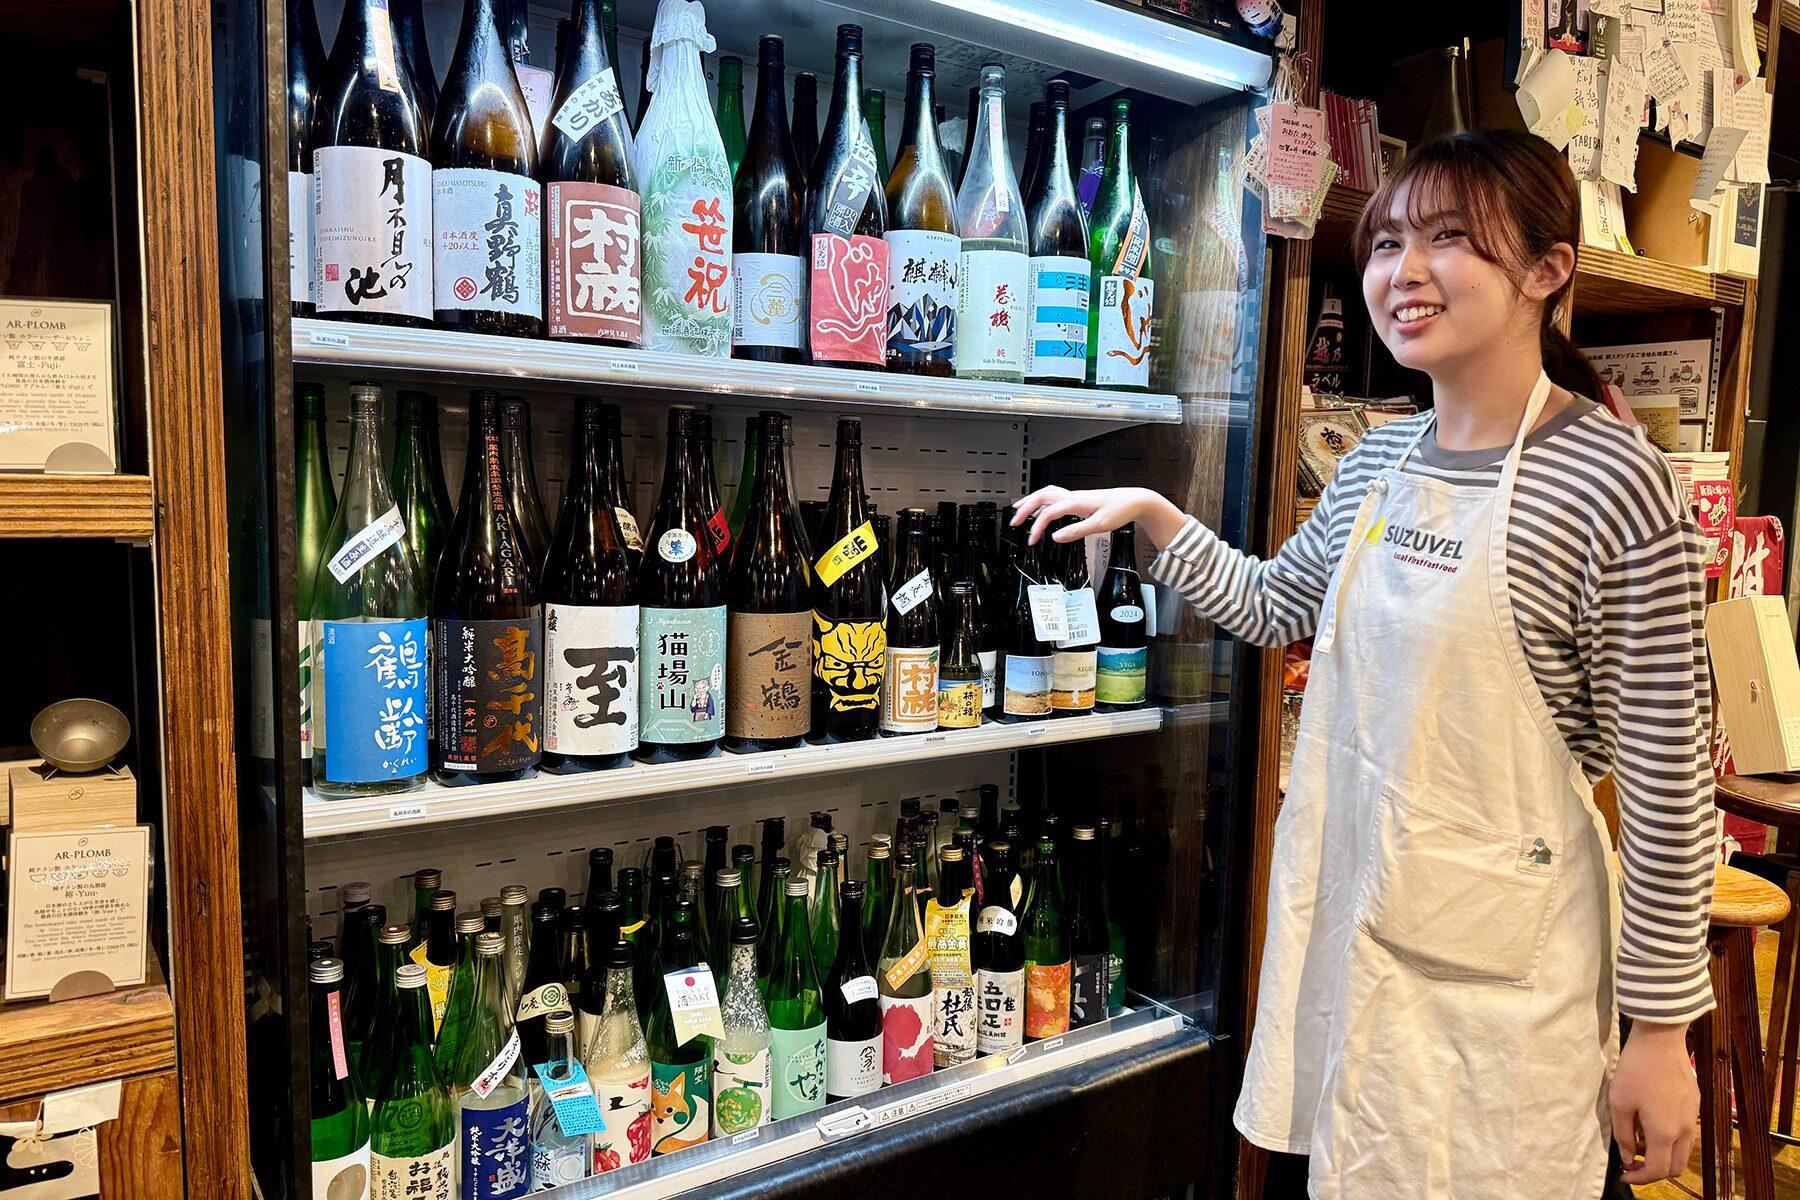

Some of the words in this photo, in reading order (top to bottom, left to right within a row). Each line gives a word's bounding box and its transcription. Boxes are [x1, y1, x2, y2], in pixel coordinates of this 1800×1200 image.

[442, 231, 478, 241] 日本酒度
[480, 183, 520, 304] 真野鶴
[681, 197, 728, 314] 笹祝
[7, 320, 67, 330] AR-PLOMB
[17, 361, 35, 369] 富士
[495, 513, 517, 586] AKIAGARI
[1384, 525, 1464, 560] SUZUVEL
[1407, 556, 1423, 566] First
[1422, 559, 1440, 570] Fast
[1438, 562, 1458, 574] Food
[1119, 610, 1138, 618] 2024
[461, 625, 478, 688] 純米大吟醸
[657, 632, 690, 710] 猫場山
[748, 636, 803, 711] 金鶴
[364, 630, 424, 755] 鶴齢
[563, 646, 636, 729] 至
[901, 662, 937, 715] 村祐
[963, 691, 974, 717] 柿の種
[382, 756, 417, 769] かくれい
[55, 848, 111, 861] AR-PLOMB
[927, 935, 969, 951] 最高金賞
[689, 992, 712, 1002] SAKE
[942, 991, 965, 1037] 杜氏
[891, 1106, 905, 1118] 注意
[484, 1116, 527, 1196] 大洋盛
